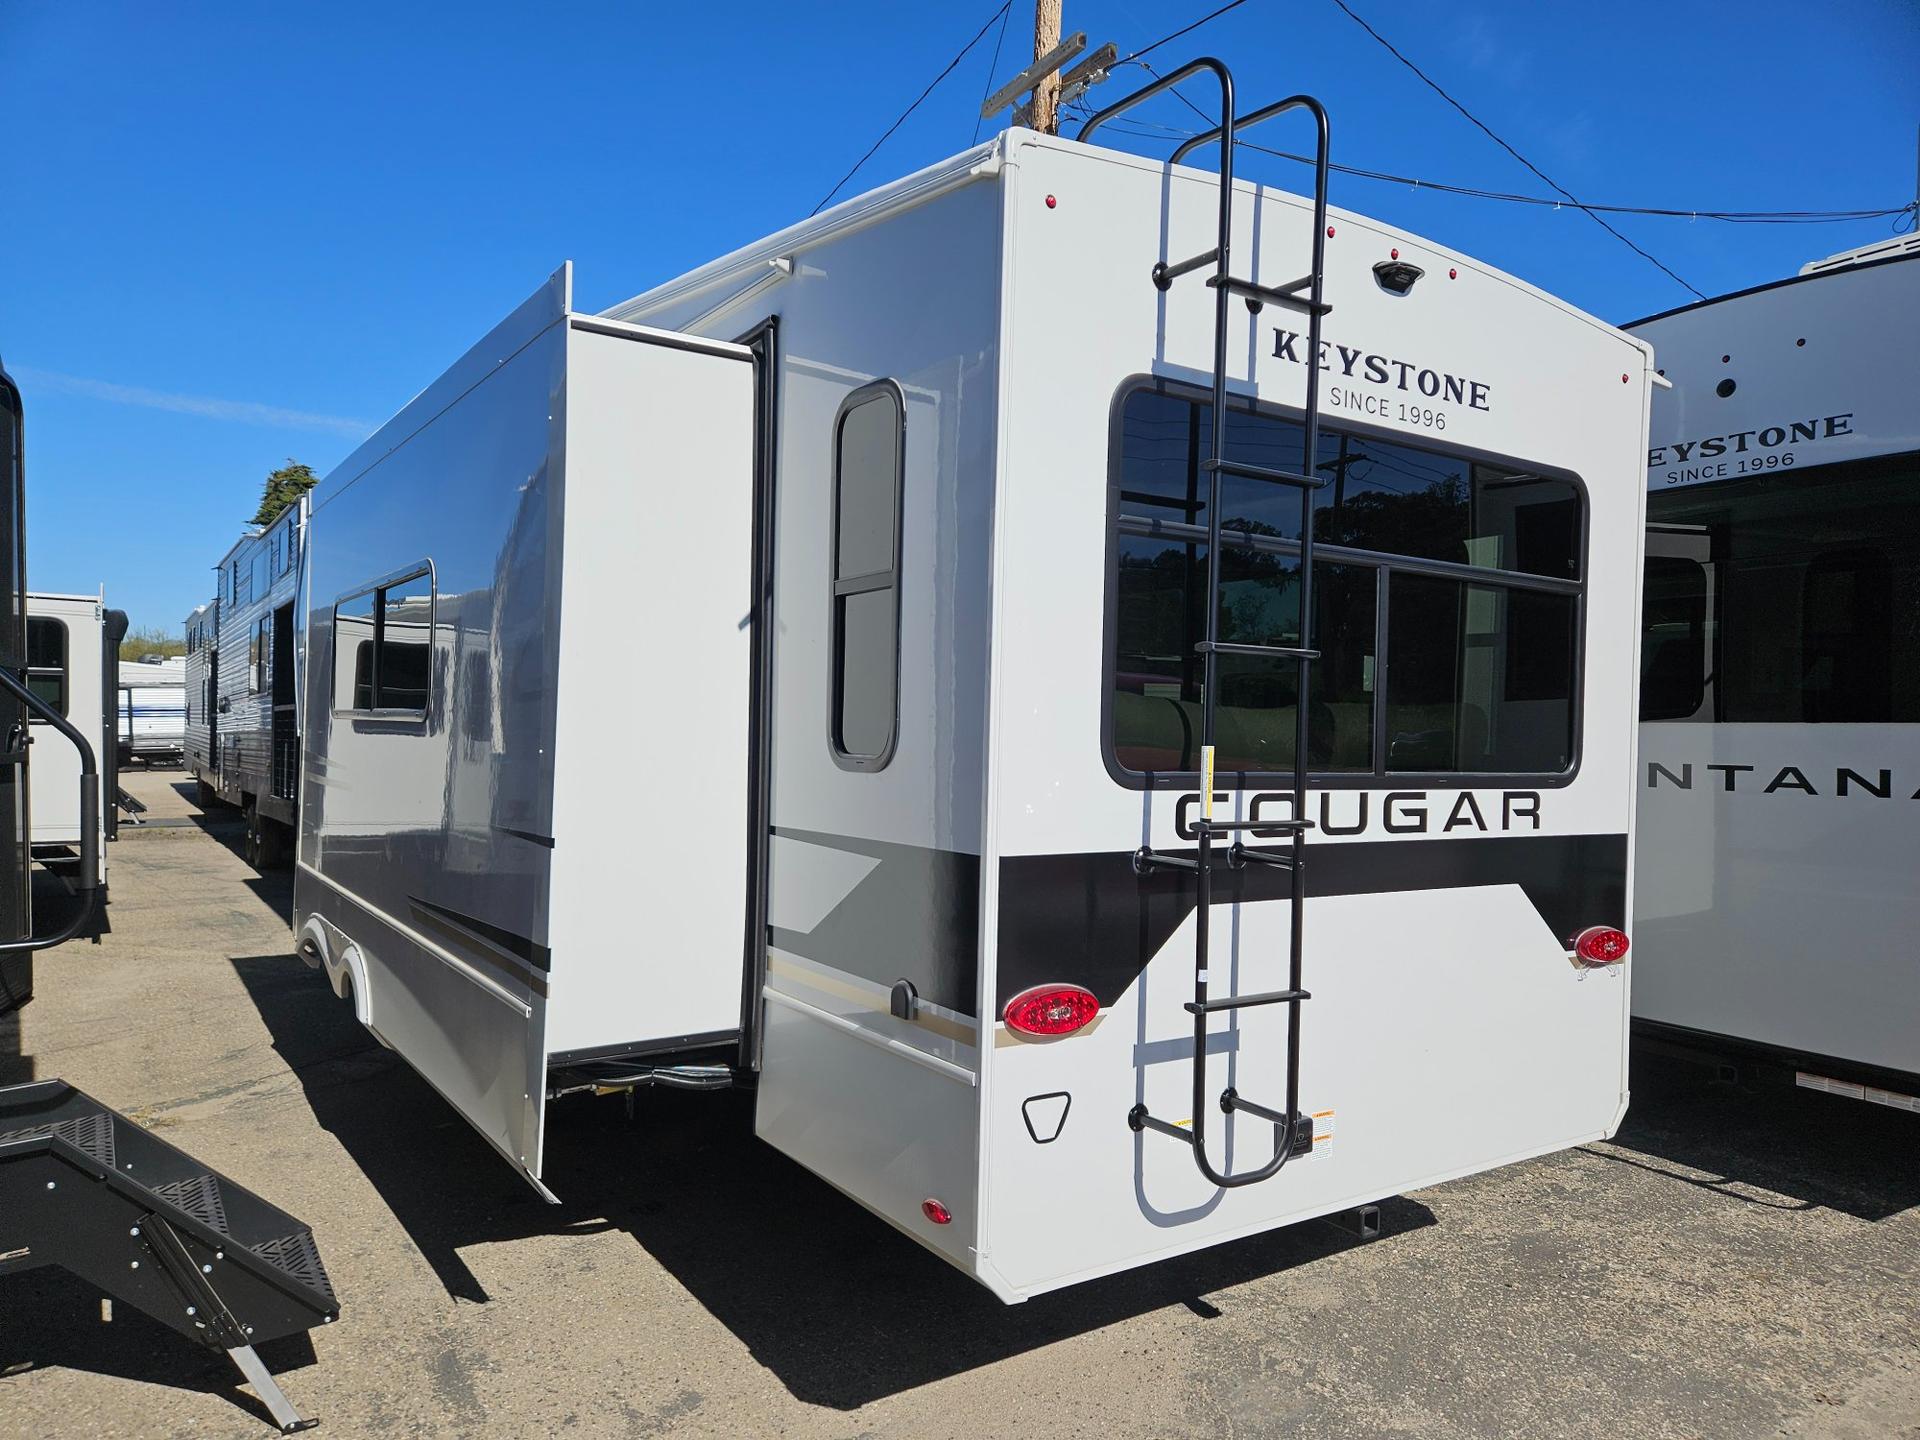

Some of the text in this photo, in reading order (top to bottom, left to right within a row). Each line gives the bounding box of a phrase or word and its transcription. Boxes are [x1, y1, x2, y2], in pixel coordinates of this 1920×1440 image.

[1272, 328, 1491, 411] KEYSTONE
[1330, 387, 1446, 430] SINCE 1996
[1667, 453, 1795, 484] SINCE 1996
[1648, 762, 1920, 799] NTAN
[1175, 791, 1541, 840] COUGAR
